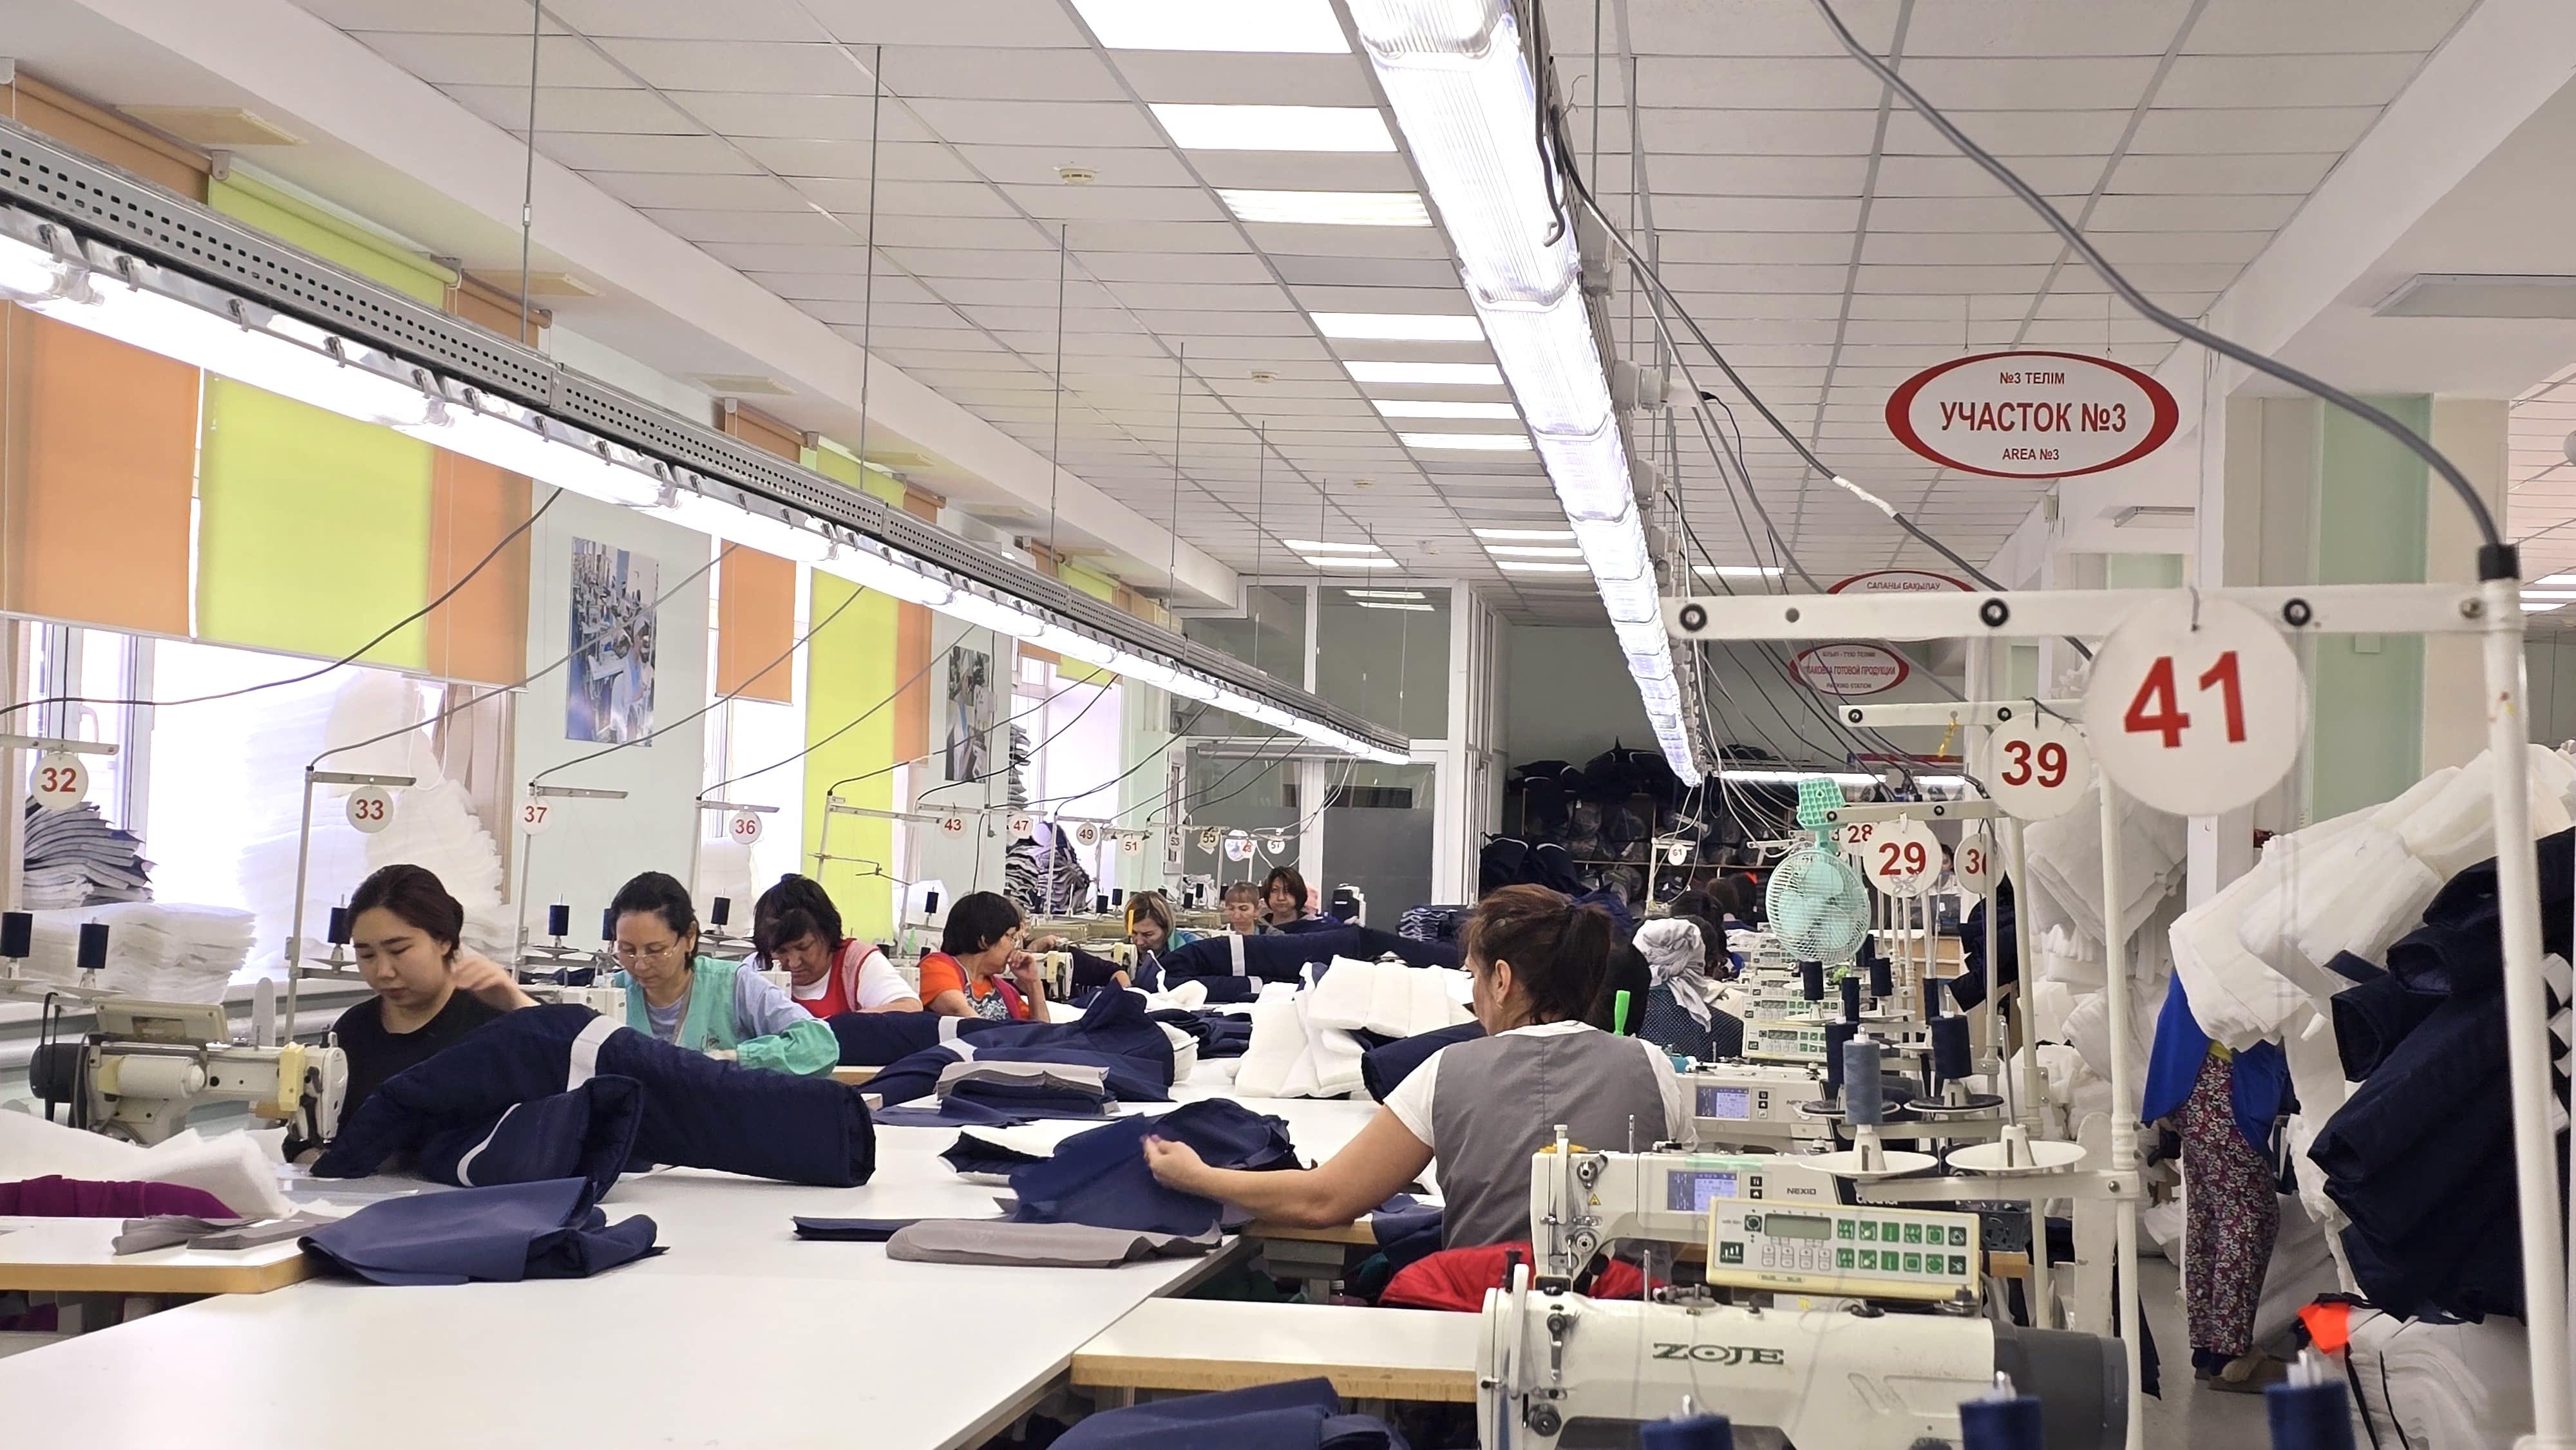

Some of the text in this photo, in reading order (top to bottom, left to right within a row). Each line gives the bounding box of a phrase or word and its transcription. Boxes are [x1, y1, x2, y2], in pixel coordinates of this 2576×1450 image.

[2000, 372, 2065, 384] №3 ТЕЛІМ
[1940, 402, 2126, 432] УЧАСТОК №3
[2002, 449, 2060, 460] AREA №3
[2124, 650, 2246, 748] 41
[2002, 740, 2068, 787] 39
[41, 767, 76, 793] 32
[355, 799, 384, 820] 33
[524, 805, 547, 824] 37
[735, 819, 755, 835] 36
[945, 820, 962, 831] 43
[1013, 820, 1028, 831] 47
[1079, 829, 1094, 840] 49
[1847, 824, 1872, 843] 28
[1124, 841, 1137, 851] 51
[1170, 836, 1179, 846] 53
[1879, 842, 1927, 876] 29
[1653, 1343, 1784, 1366] ZOJE
